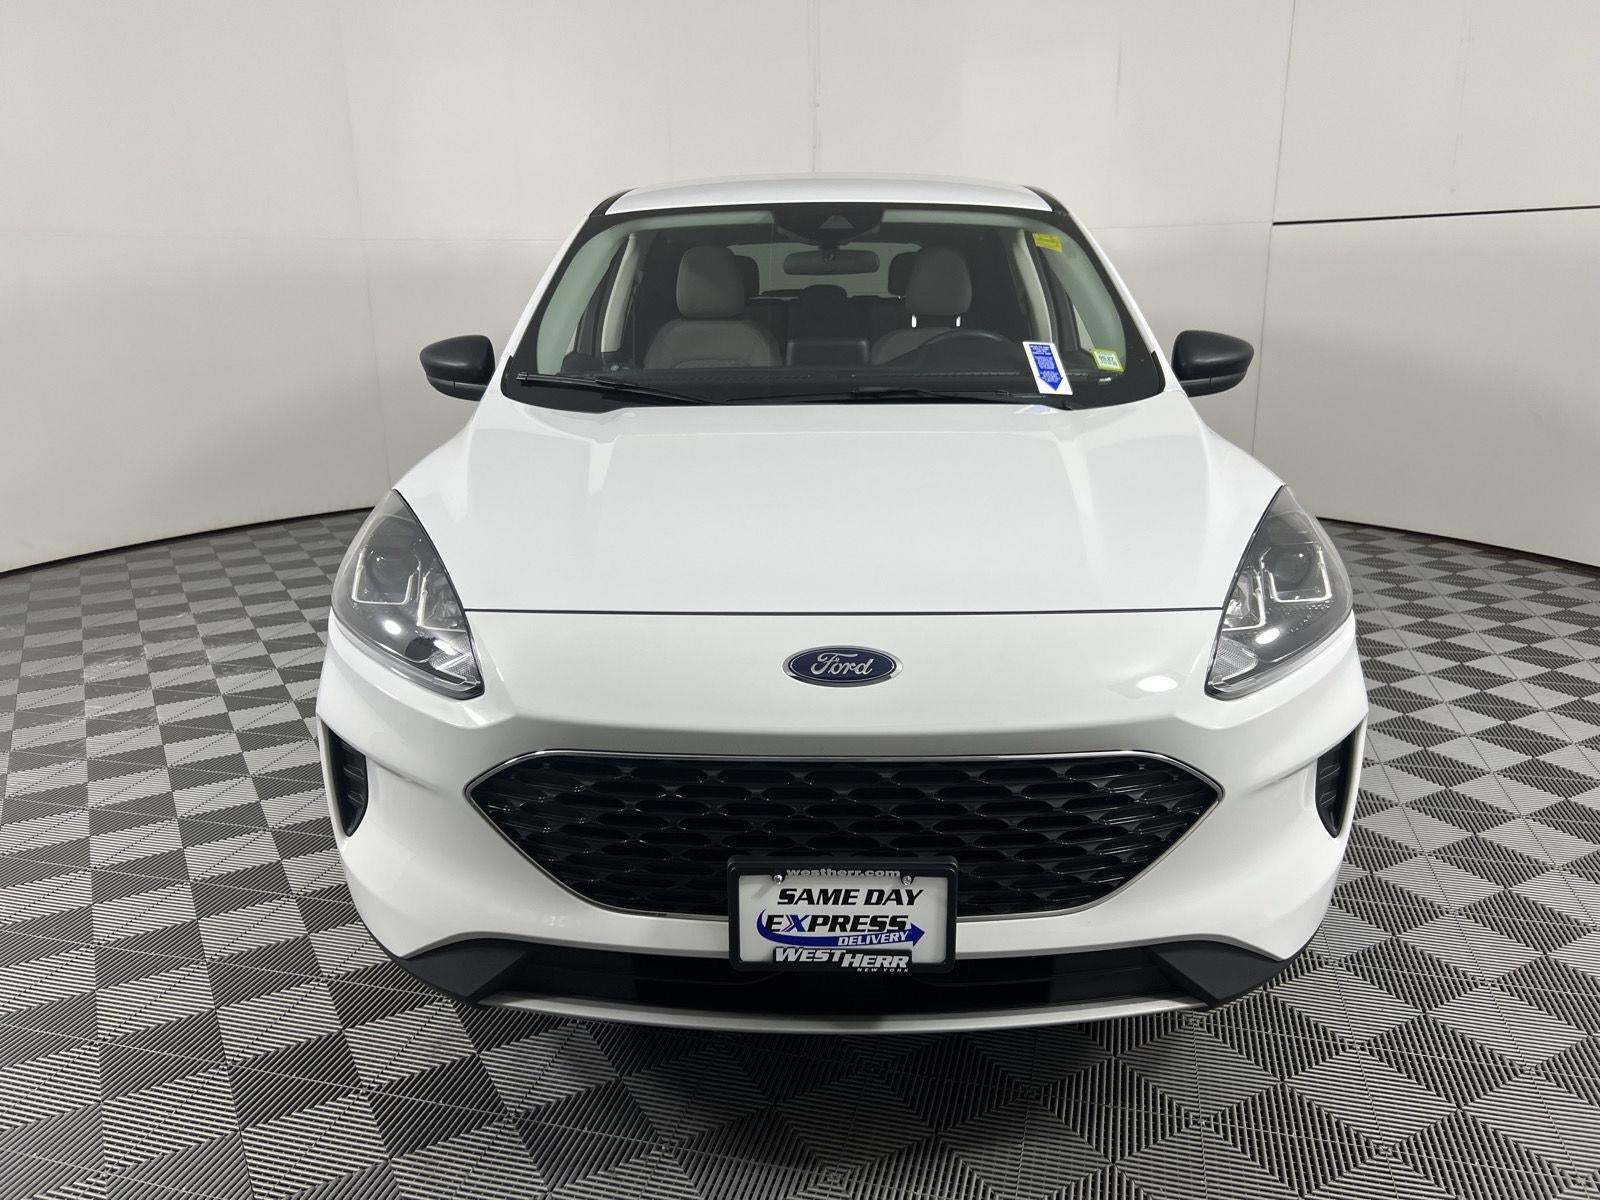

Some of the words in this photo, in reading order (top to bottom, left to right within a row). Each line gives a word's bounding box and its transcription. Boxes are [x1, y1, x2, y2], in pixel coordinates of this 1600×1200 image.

[810, 652, 873, 675] Ford
[786, 868, 900, 878] westherr.com
[777, 888, 860, 906] SAME
[864, 888, 924, 906] DAY
[765, 914, 908, 933] EXPRESS
[837, 931, 909, 946] DELIVERY
